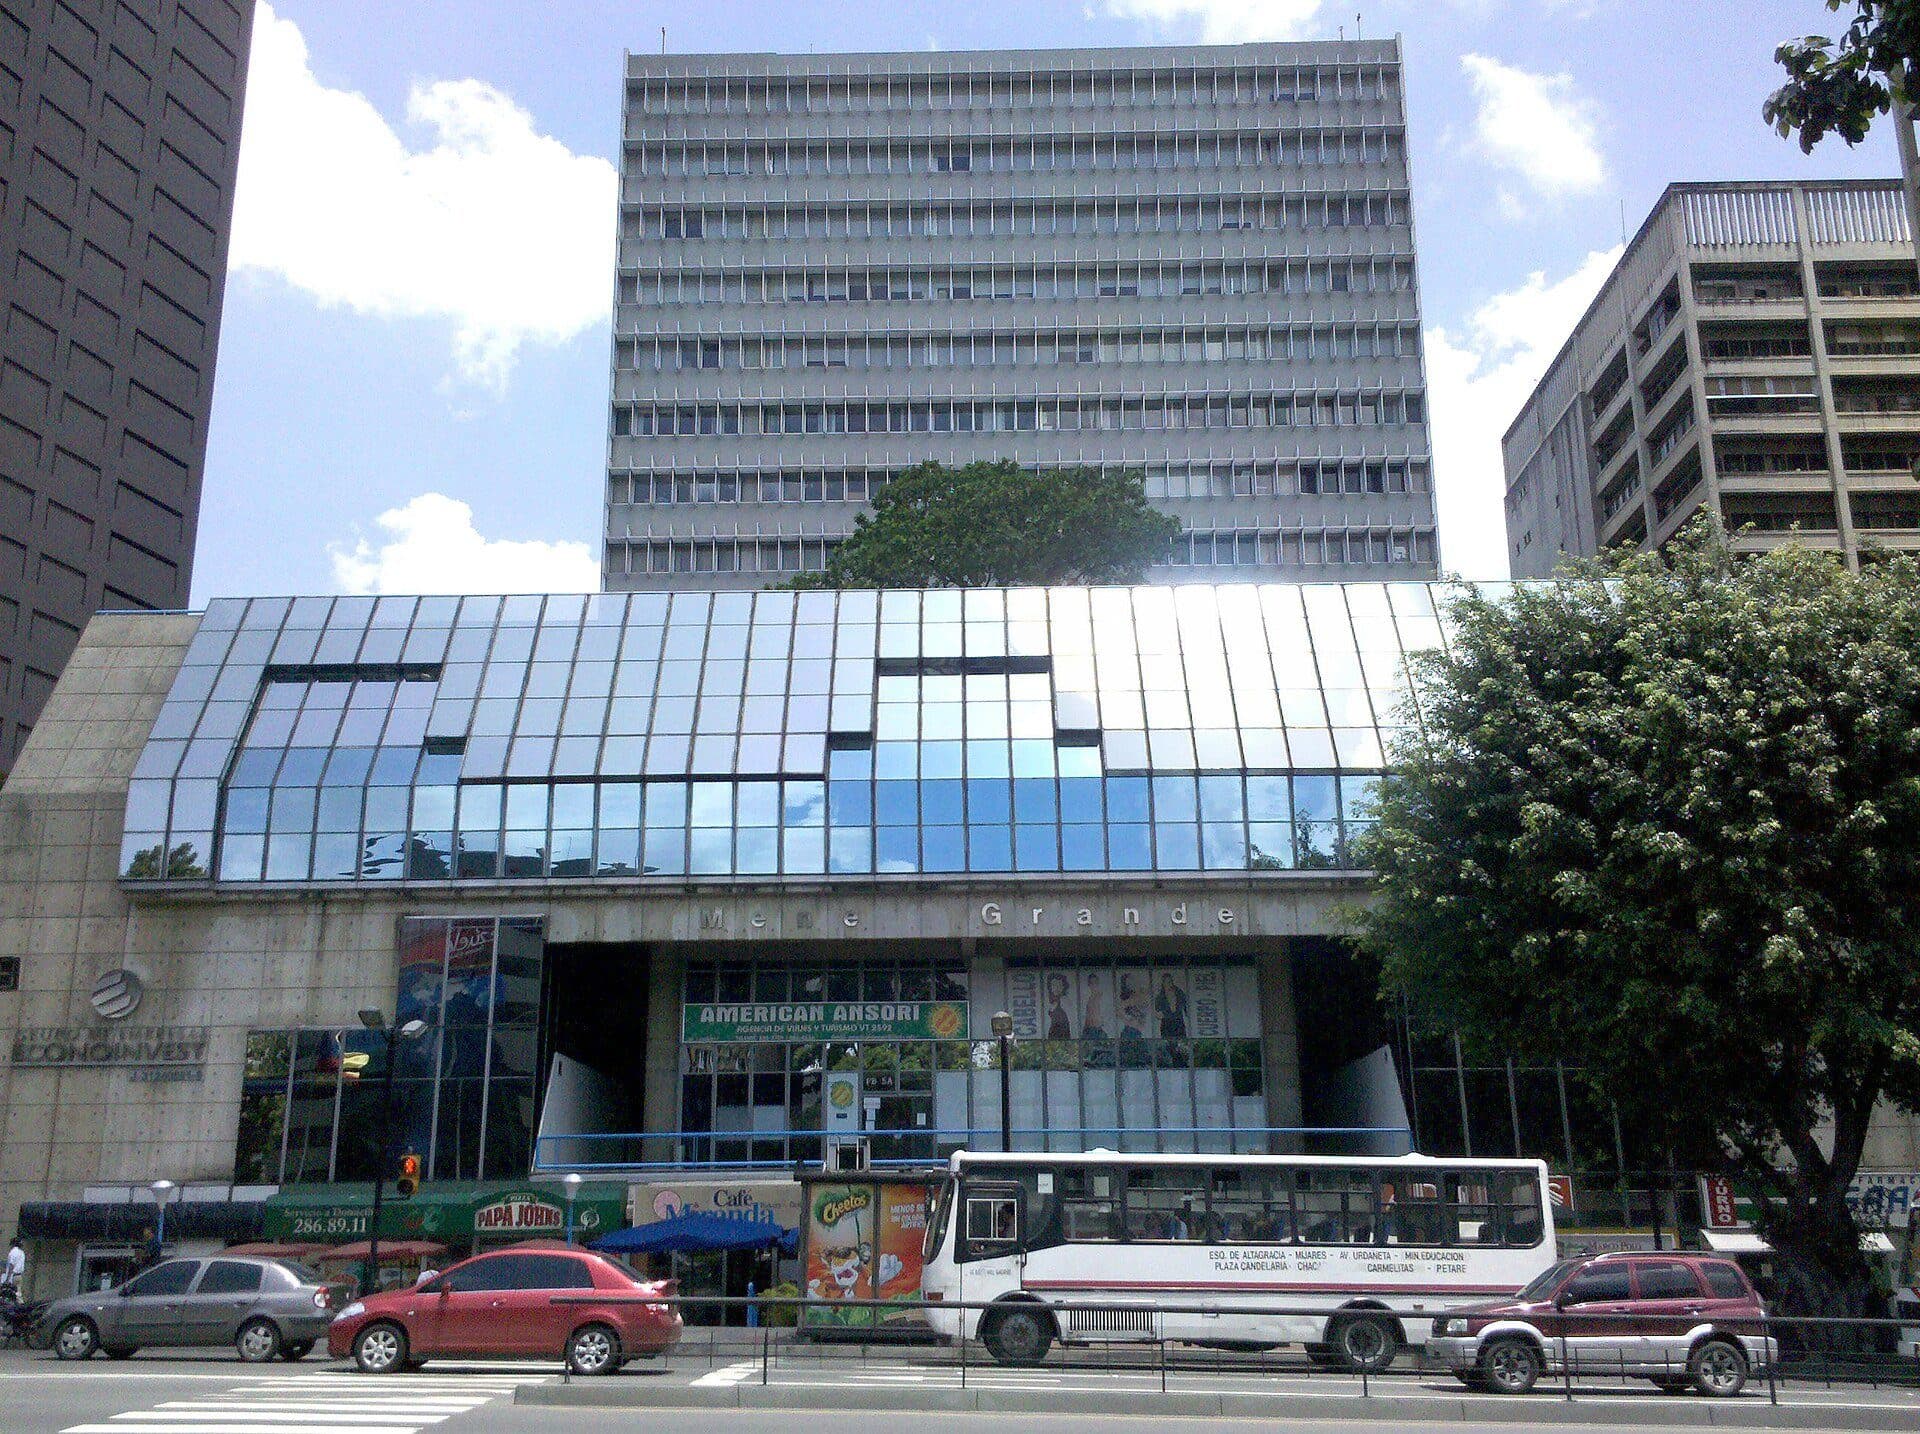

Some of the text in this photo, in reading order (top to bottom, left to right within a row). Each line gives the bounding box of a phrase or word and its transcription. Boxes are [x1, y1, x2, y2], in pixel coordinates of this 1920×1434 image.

[981, 902, 1234, 925] Grande
[701, 1004, 920, 1023] AMERICAN ANSORI
[1013, 974, 1037, 1036] CABELLO
[774, 1025, 784, 1033] DE
[12, 1042, 205, 1062] ECONOINVEST
[1858, 1176, 1915, 1184] FARMAC
[713, 1189, 753, 1207] Café
[478, 1205, 513, 1227] PAPA
[823, 1194, 867, 1223] Cheetos
[293, 1217, 367, 1233] 286.89.11
[1230, 1251, 1239, 1259] DE
[1243, 1251, 1286, 1259] ALTAGRACIA
[1295, 1251, 1327, 1259] MIJARES
[1352, 1251, 1391, 1260] URDANETA
[1215, 1262, 1239, 1271] PLAZA
[1240, 1262, 1288, 1271] CANDELARIA
[1367, 1263, 1414, 1272] CARMELITAS
[1436, 1264, 1466, 1273] PETARE
